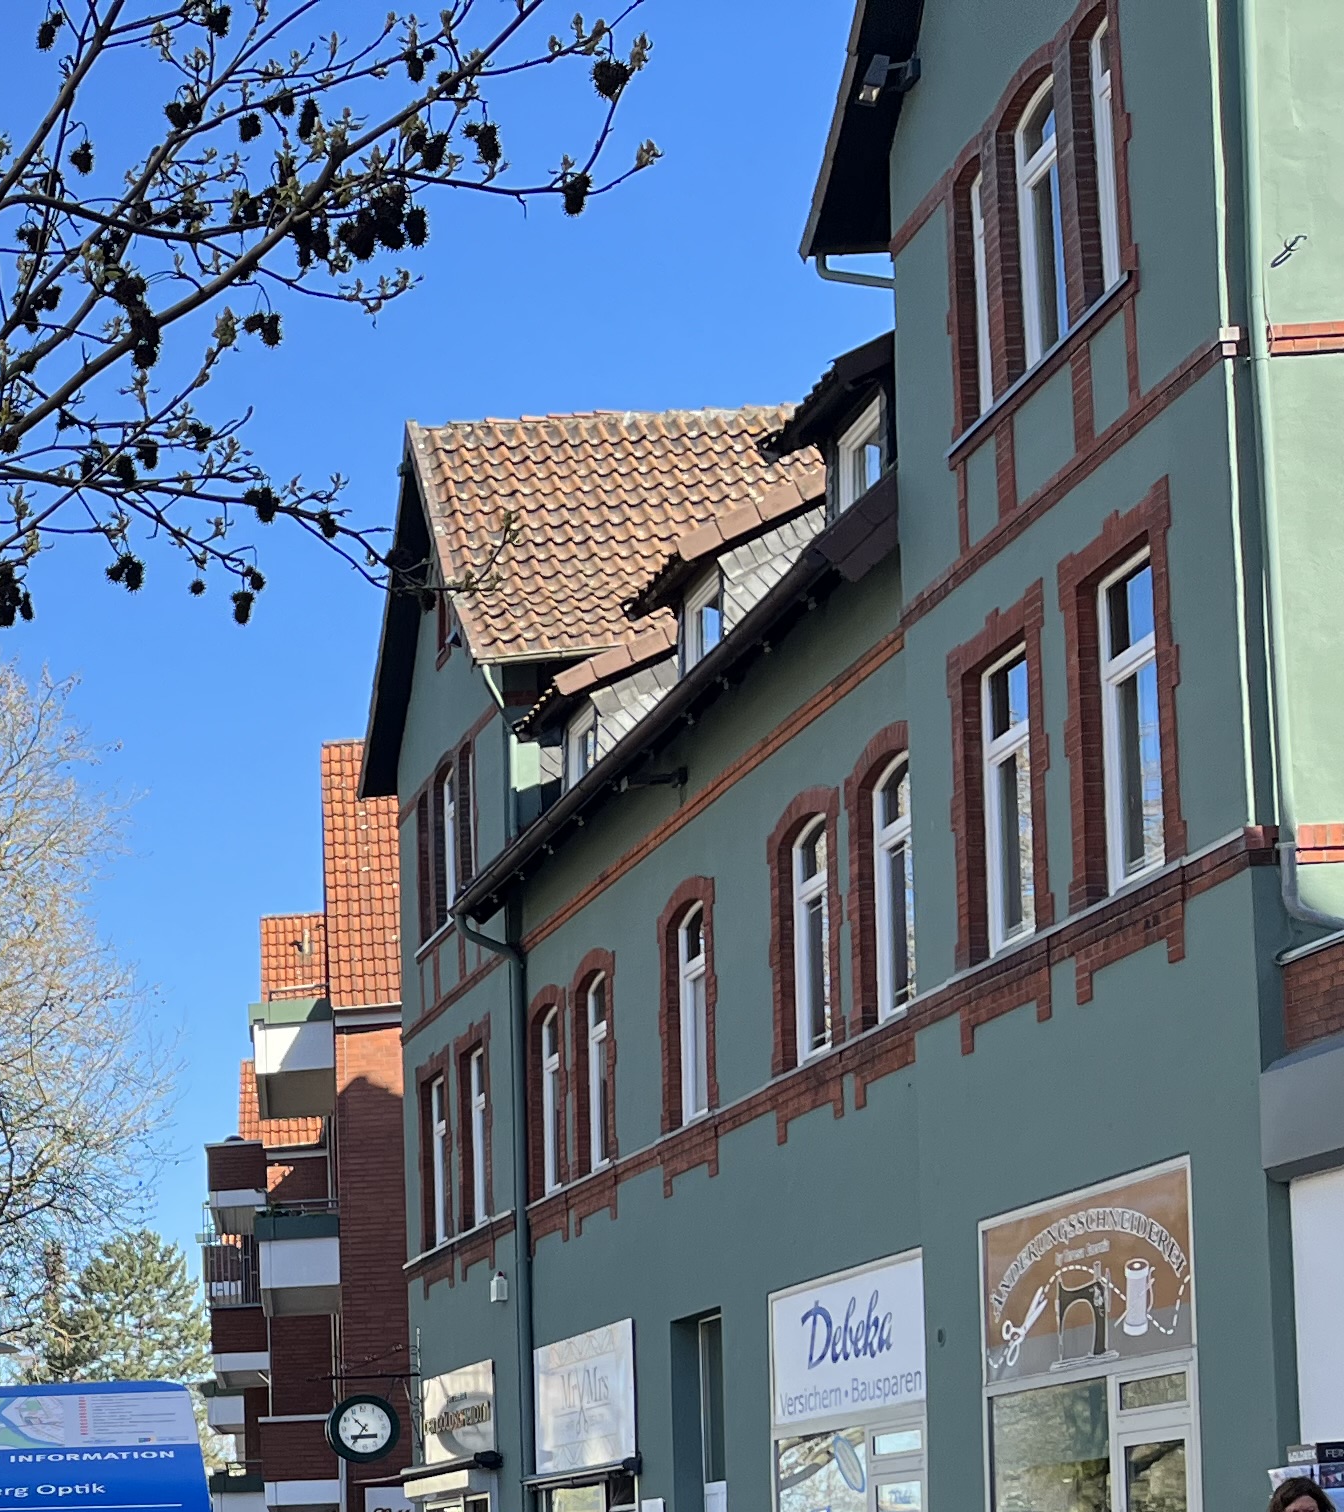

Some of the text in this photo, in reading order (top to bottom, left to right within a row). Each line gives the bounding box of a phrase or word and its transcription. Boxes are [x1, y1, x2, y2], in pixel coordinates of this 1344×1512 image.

[800, 1289, 894, 1371] Debeka
[780, 1369, 922, 1416] Versichern Bausparen
[9, 1450, 176, 1464] INFORMATION
[36, 1482, 106, 1498] Optik
